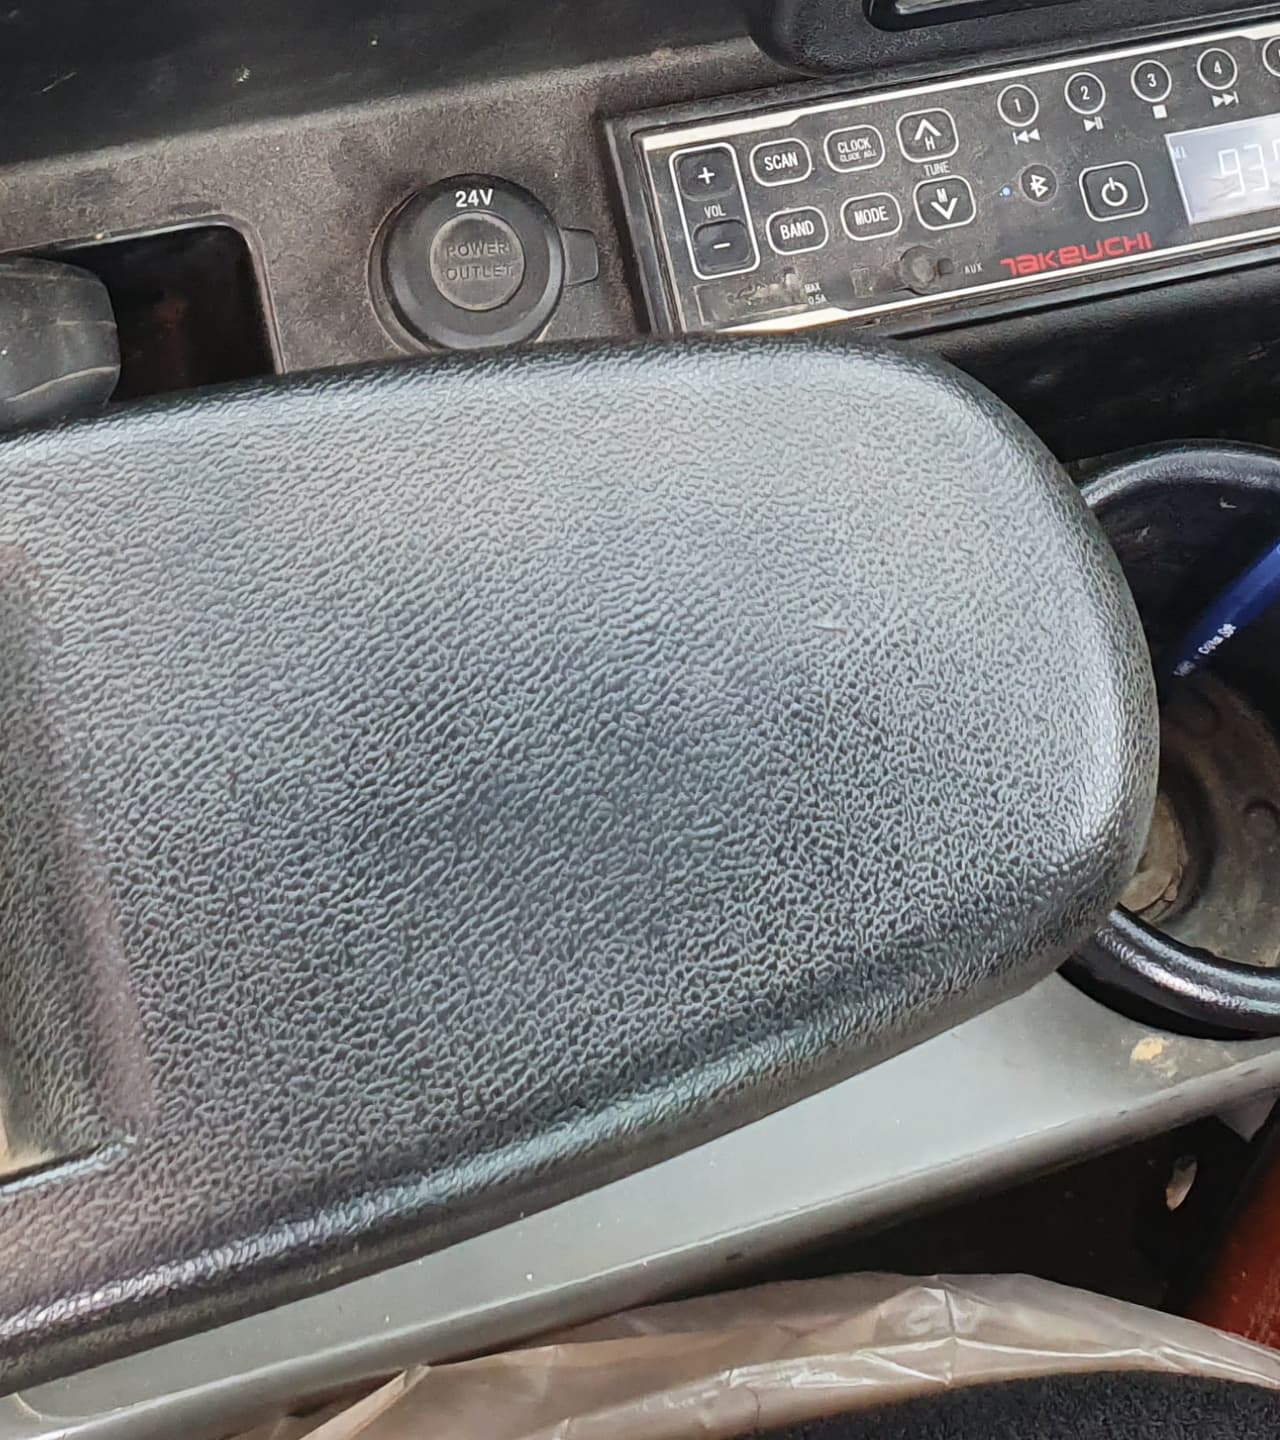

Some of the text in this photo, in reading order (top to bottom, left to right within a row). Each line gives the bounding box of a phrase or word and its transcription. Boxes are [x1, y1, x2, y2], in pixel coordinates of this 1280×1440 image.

[1213, 60, 1222, 75] 4
[1147, 73, 1157, 88] 3
[1081, 86, 1090, 101] 2
[1014, 99, 1021, 112] 1
[837, 137, 871, 154] CLOCK
[925, 136, 935, 151] H
[764, 152, 798, 171] SCAN
[924, 161, 951, 176] TUNE
[455, 189, 493, 207] 24V
[704, 204, 726, 219] VOL
[854, 206, 889, 225] MODE
[780, 220, 815, 240] BAND
[446, 241, 510, 258] POWER
[446, 263, 514, 281] OUTLET
[964, 263, 983, 275] AUX
